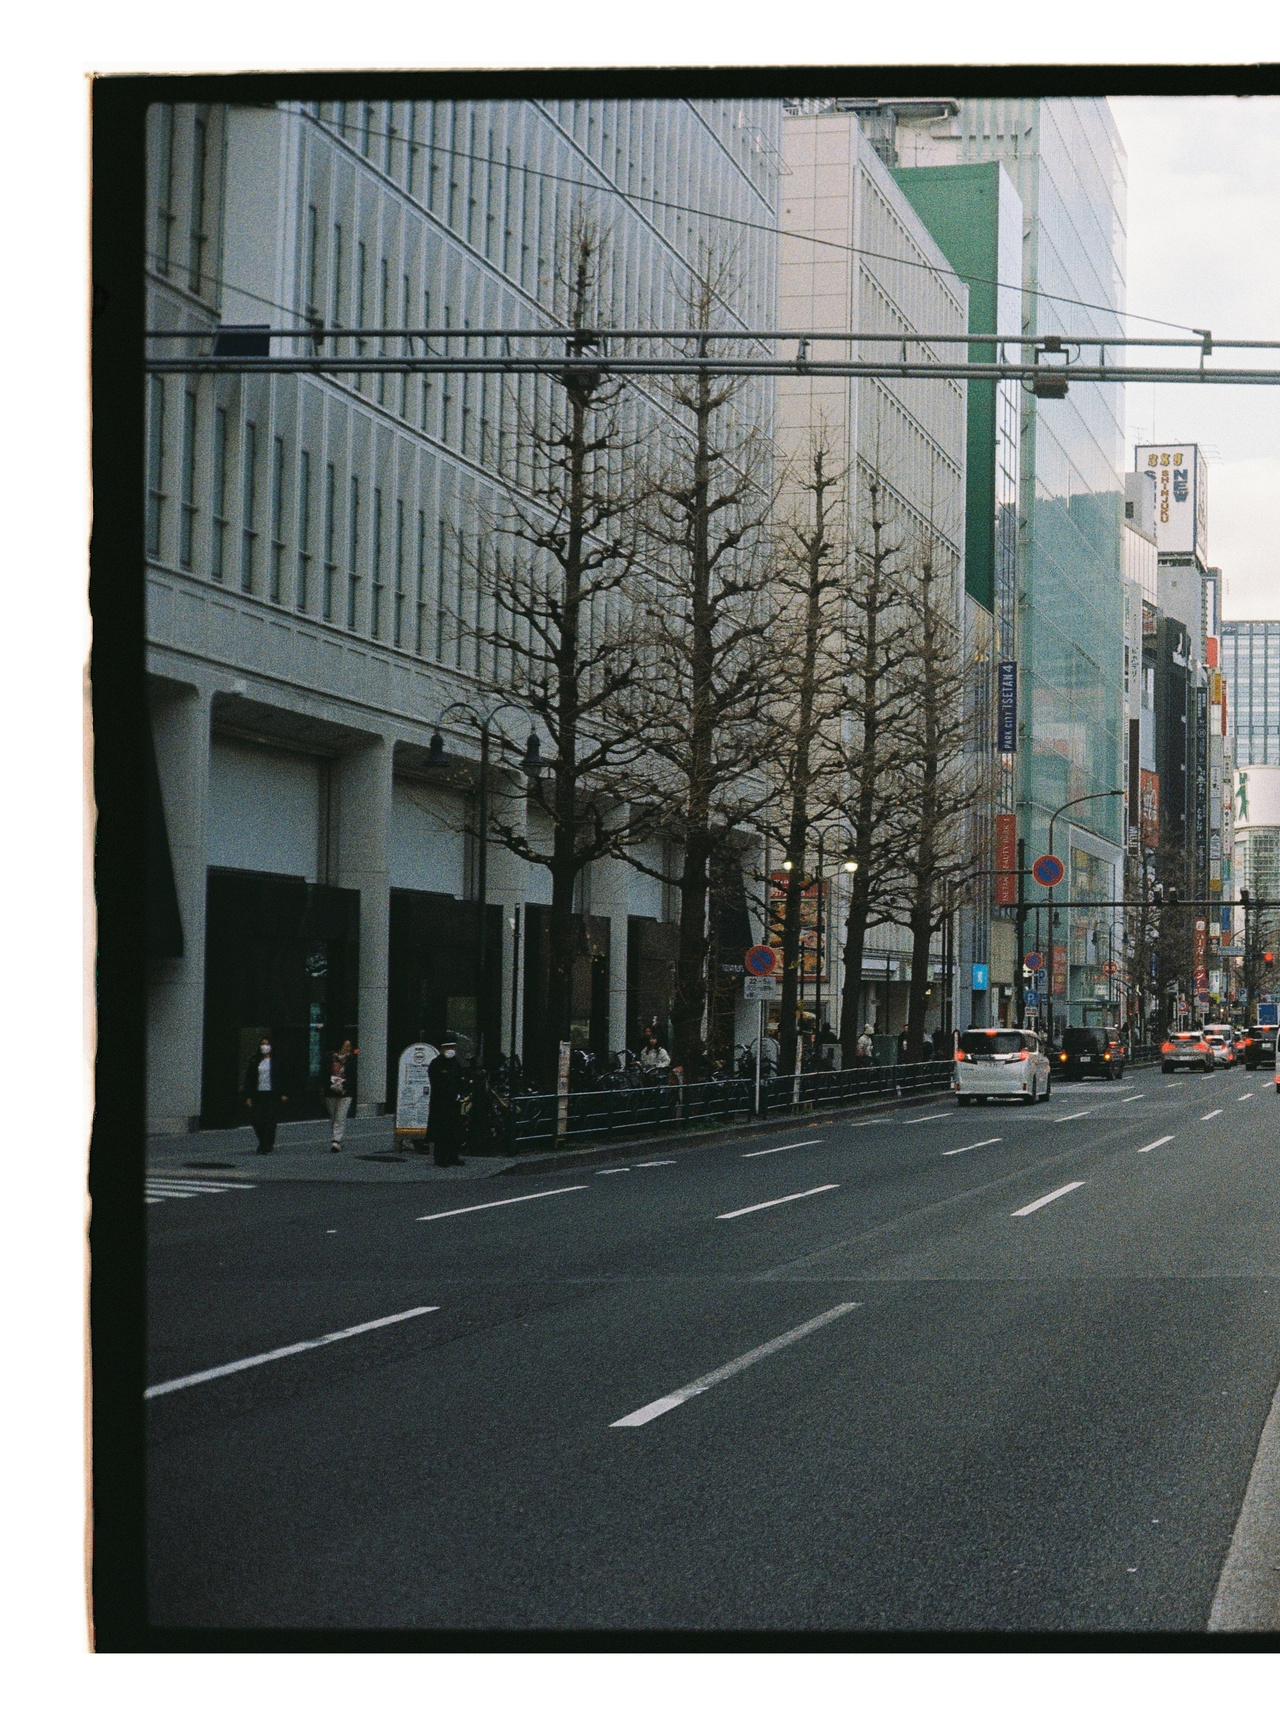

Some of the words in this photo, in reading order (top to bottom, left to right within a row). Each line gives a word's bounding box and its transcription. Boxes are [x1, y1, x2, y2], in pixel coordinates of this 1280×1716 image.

[1161, 470, 1170, 524] SHINJUKU
[1173, 469, 1189, 503] NEW
[1002, 673, 1013, 708] ISETAN
[1004, 711, 1013, 728] CITY
[1004, 731, 1013, 749] PARK
[1002, 845, 1010, 873] EAUTY
